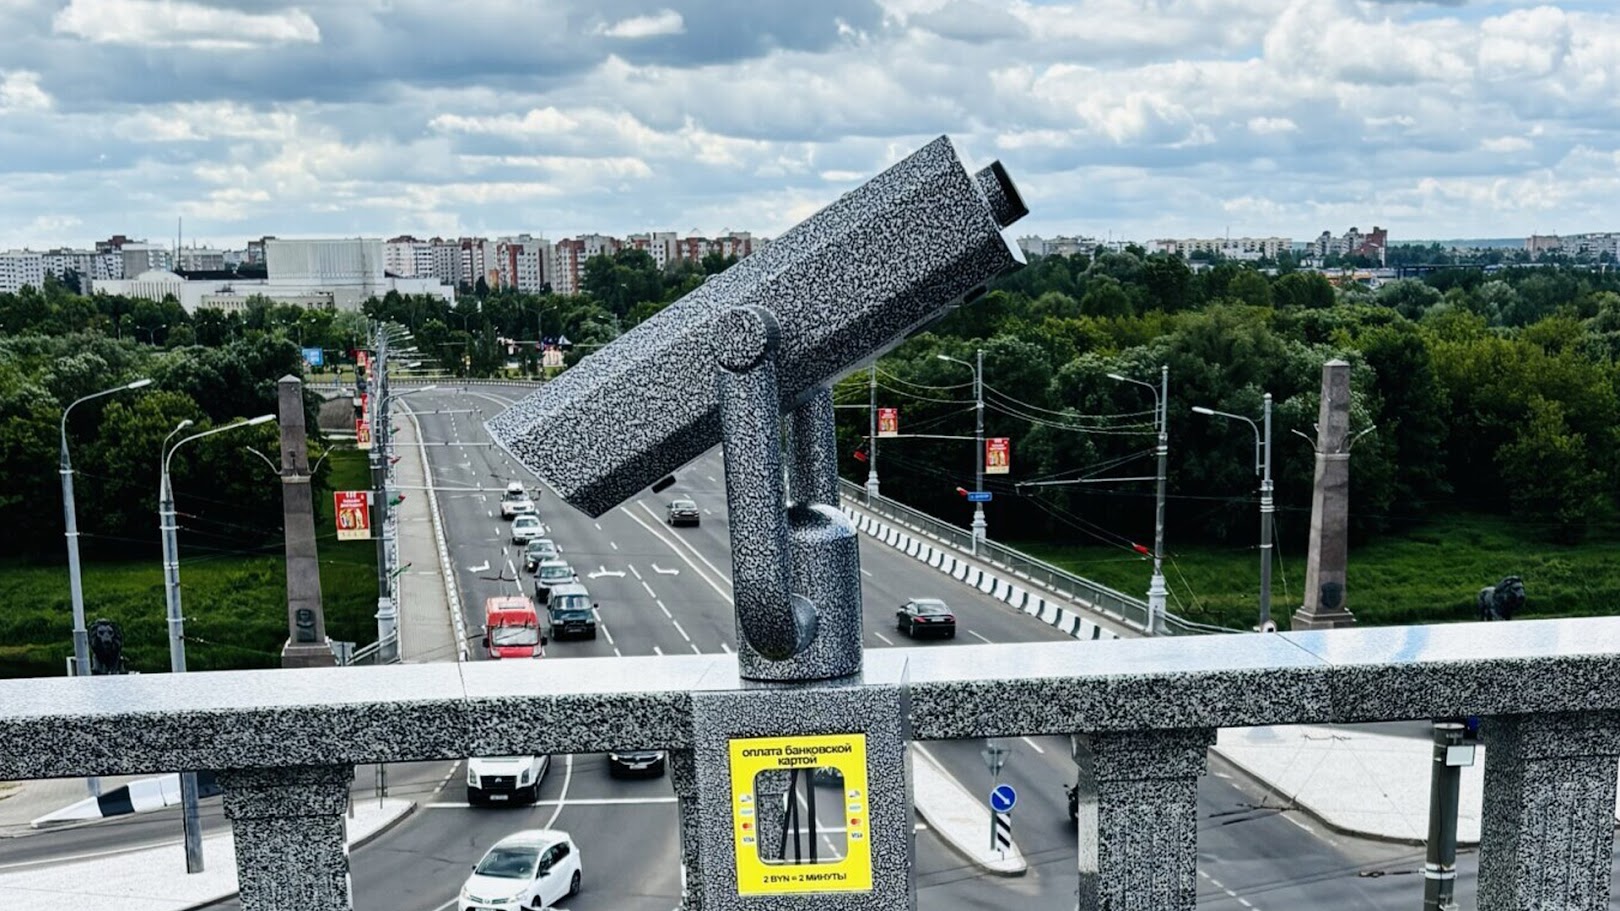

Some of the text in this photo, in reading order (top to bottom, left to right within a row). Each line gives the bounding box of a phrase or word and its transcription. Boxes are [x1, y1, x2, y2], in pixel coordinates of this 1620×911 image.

[742, 743, 852, 758] оплата банковской
[778, 755, 817, 767] картой
[763, 875, 770, 883] 2
[770, 875, 790, 883] BYN
[799, 874, 804, 882] 2
[805, 873, 847, 882] МИНУТЫ
